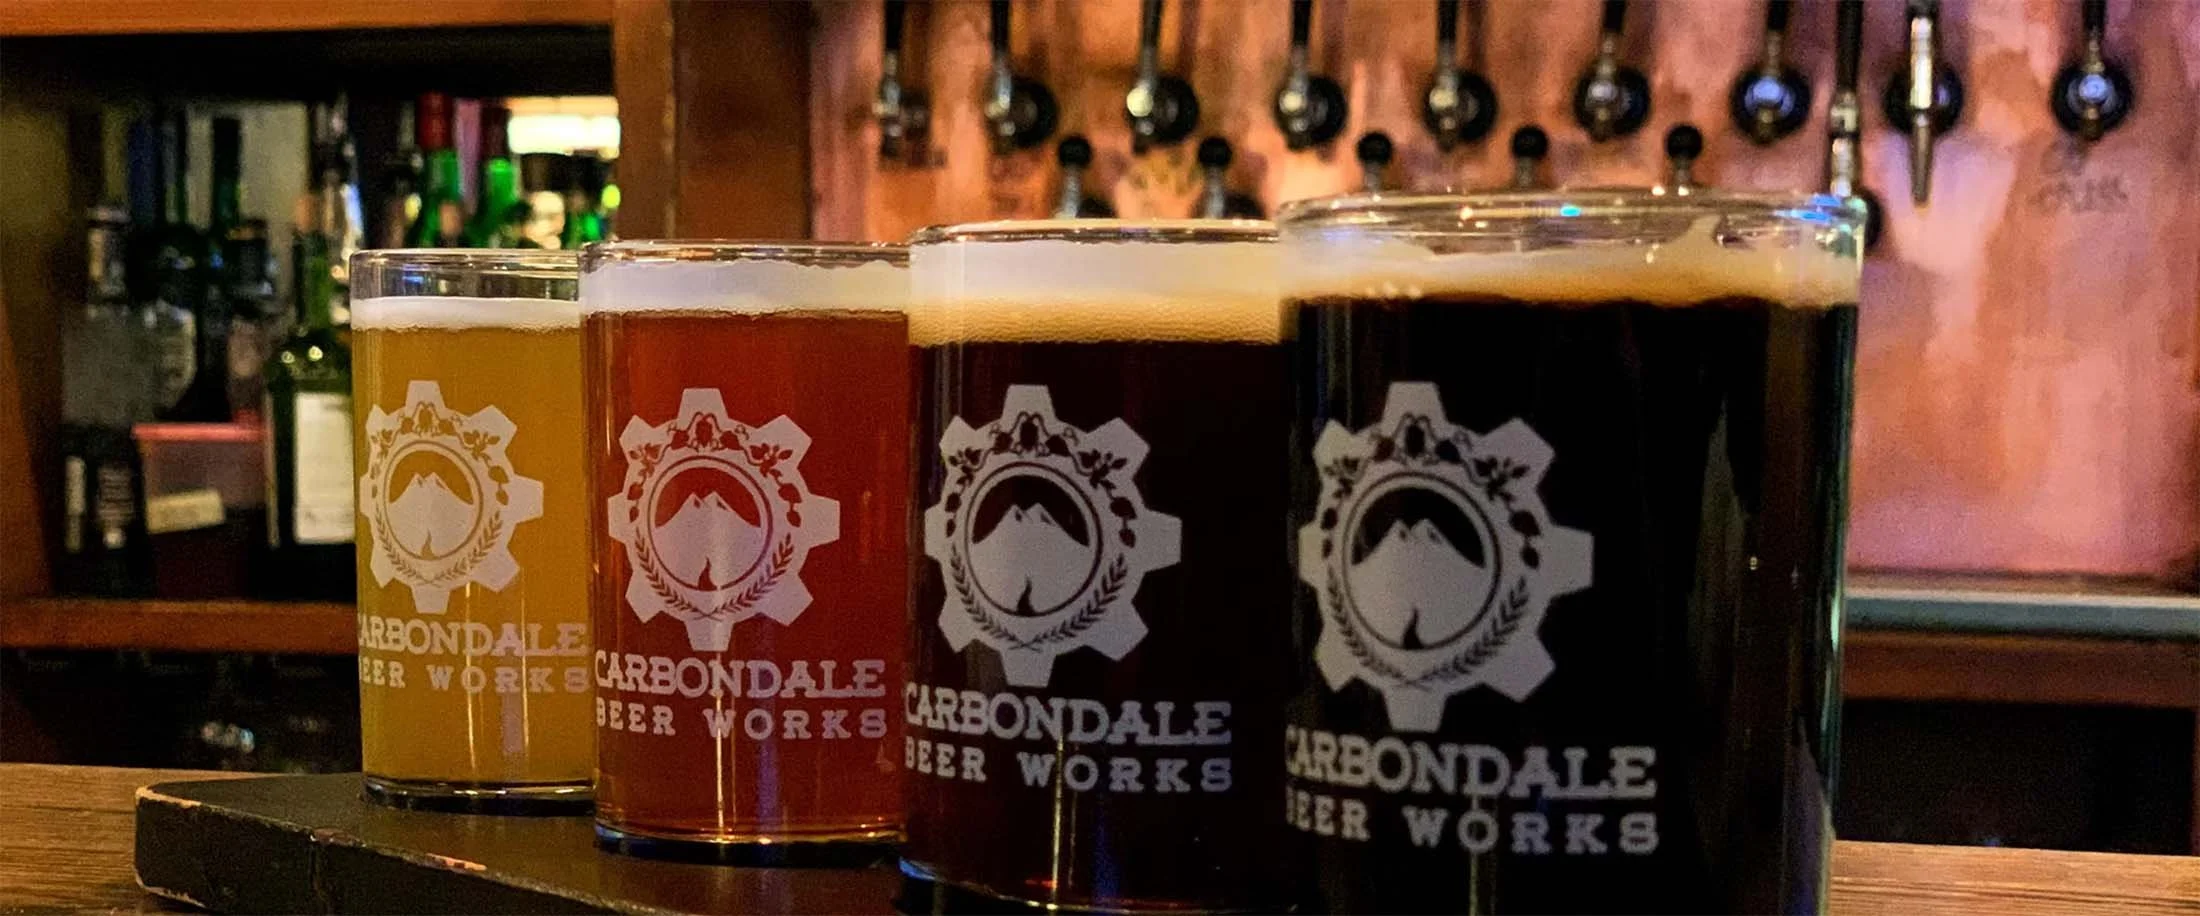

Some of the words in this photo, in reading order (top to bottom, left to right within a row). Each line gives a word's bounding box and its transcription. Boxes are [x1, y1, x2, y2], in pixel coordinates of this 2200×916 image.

[357, 613, 589, 657] ARBONDALE
[359, 655, 406, 689] EER
[426, 664, 591, 693] WORKS
[595, 650, 886, 698] CARBONDALE
[596, 697, 676, 736] BEER
[703, 708, 887, 740] WORKS
[904, 682, 1232, 745] CARBONDALE
[1016, 752, 1232, 792] WORKS
[1402, 805, 1659, 855] WORKS
